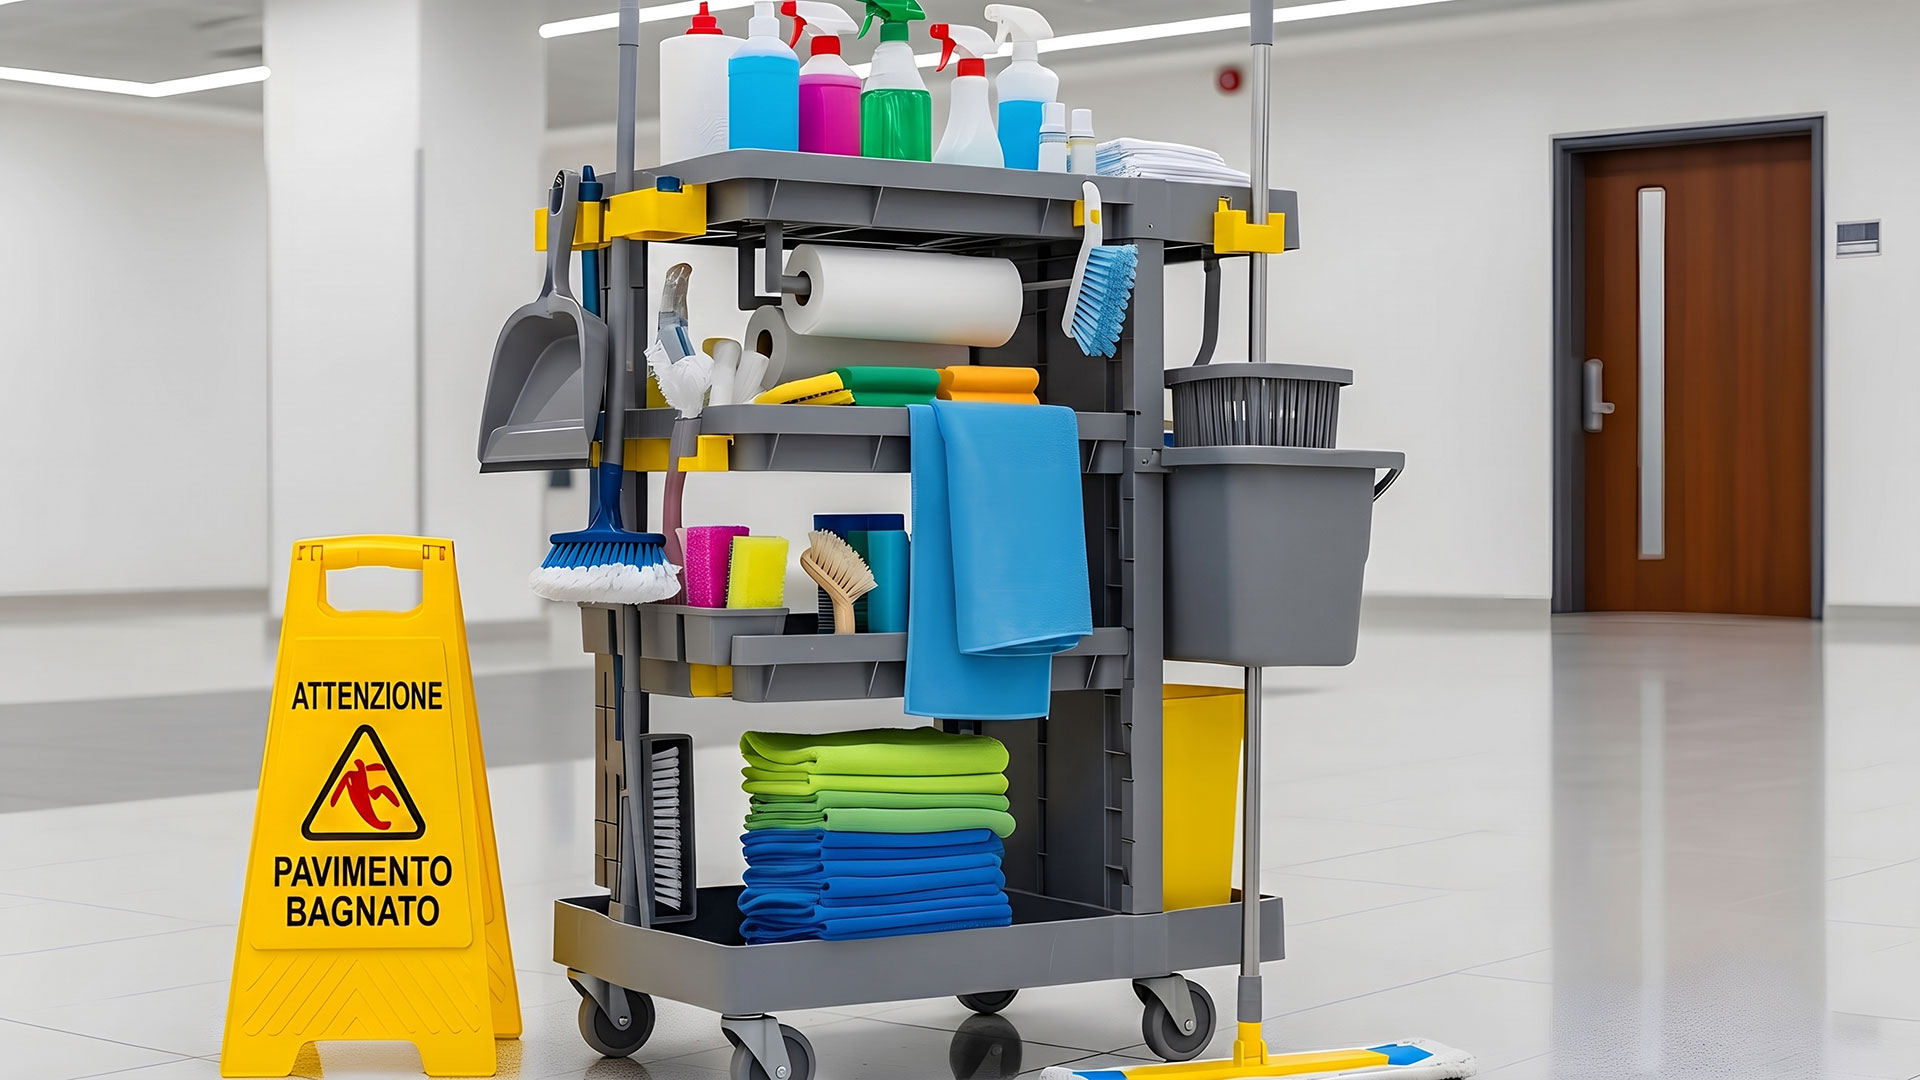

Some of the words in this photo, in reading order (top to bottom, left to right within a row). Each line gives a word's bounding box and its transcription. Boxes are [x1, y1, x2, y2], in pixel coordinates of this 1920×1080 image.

[291, 681, 443, 710] ATTENZIONE
[274, 855, 452, 887] PAVIMENTO
[286, 895, 440, 927] BAGNATO
